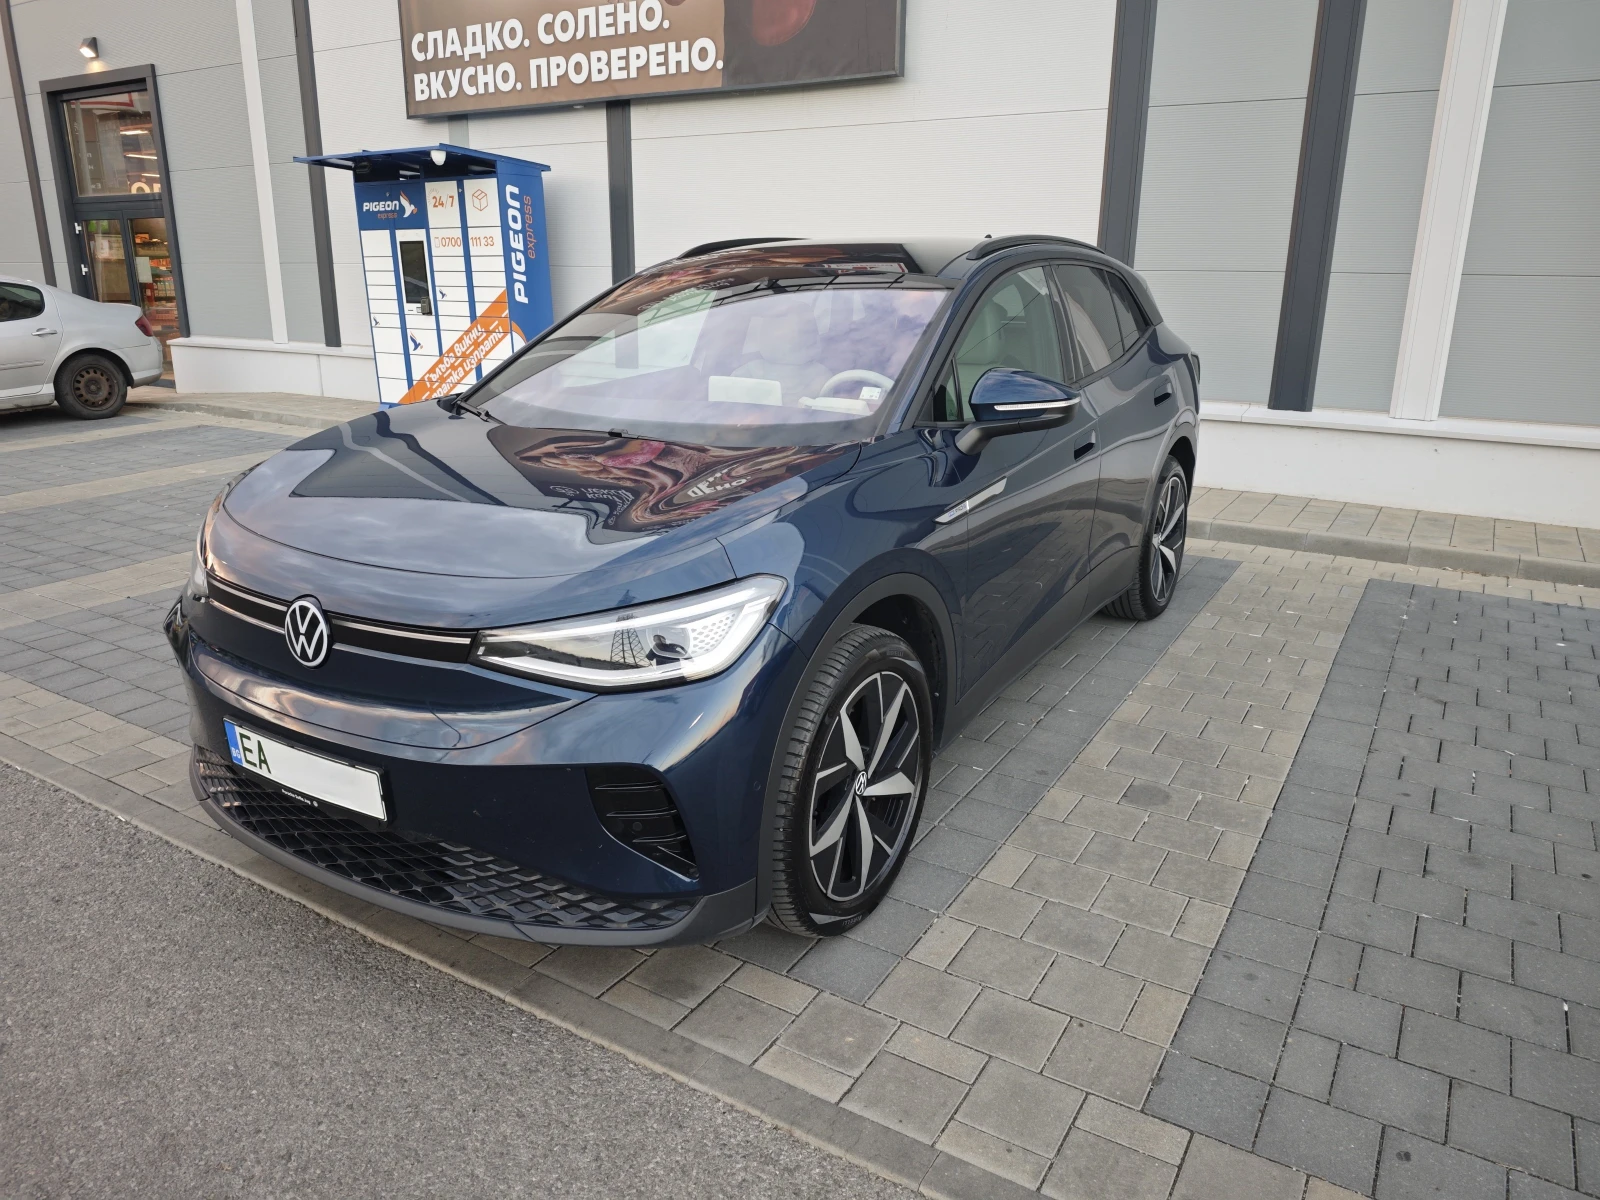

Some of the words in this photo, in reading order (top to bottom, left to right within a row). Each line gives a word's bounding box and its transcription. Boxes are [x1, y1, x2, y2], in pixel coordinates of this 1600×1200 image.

[411, 18, 530, 62] СЛАДКО.
[537, 0, 670, 44] СОЛЕНО.
[413, 61, 522, 102] ВКУСНО.
[529, 37, 724, 89] ПРОВЕРЕНО.
[363, 200, 400, 212] PIGEON
[432, 193, 455, 210] 24/7
[523, 195, 536, 259] express
[441, 236, 462, 248] 0700
[470, 236, 482, 247] 111
[483, 236, 495, 247] 33
[505, 184, 529, 304] PIGEON
[239, 731, 272, 775] EA
